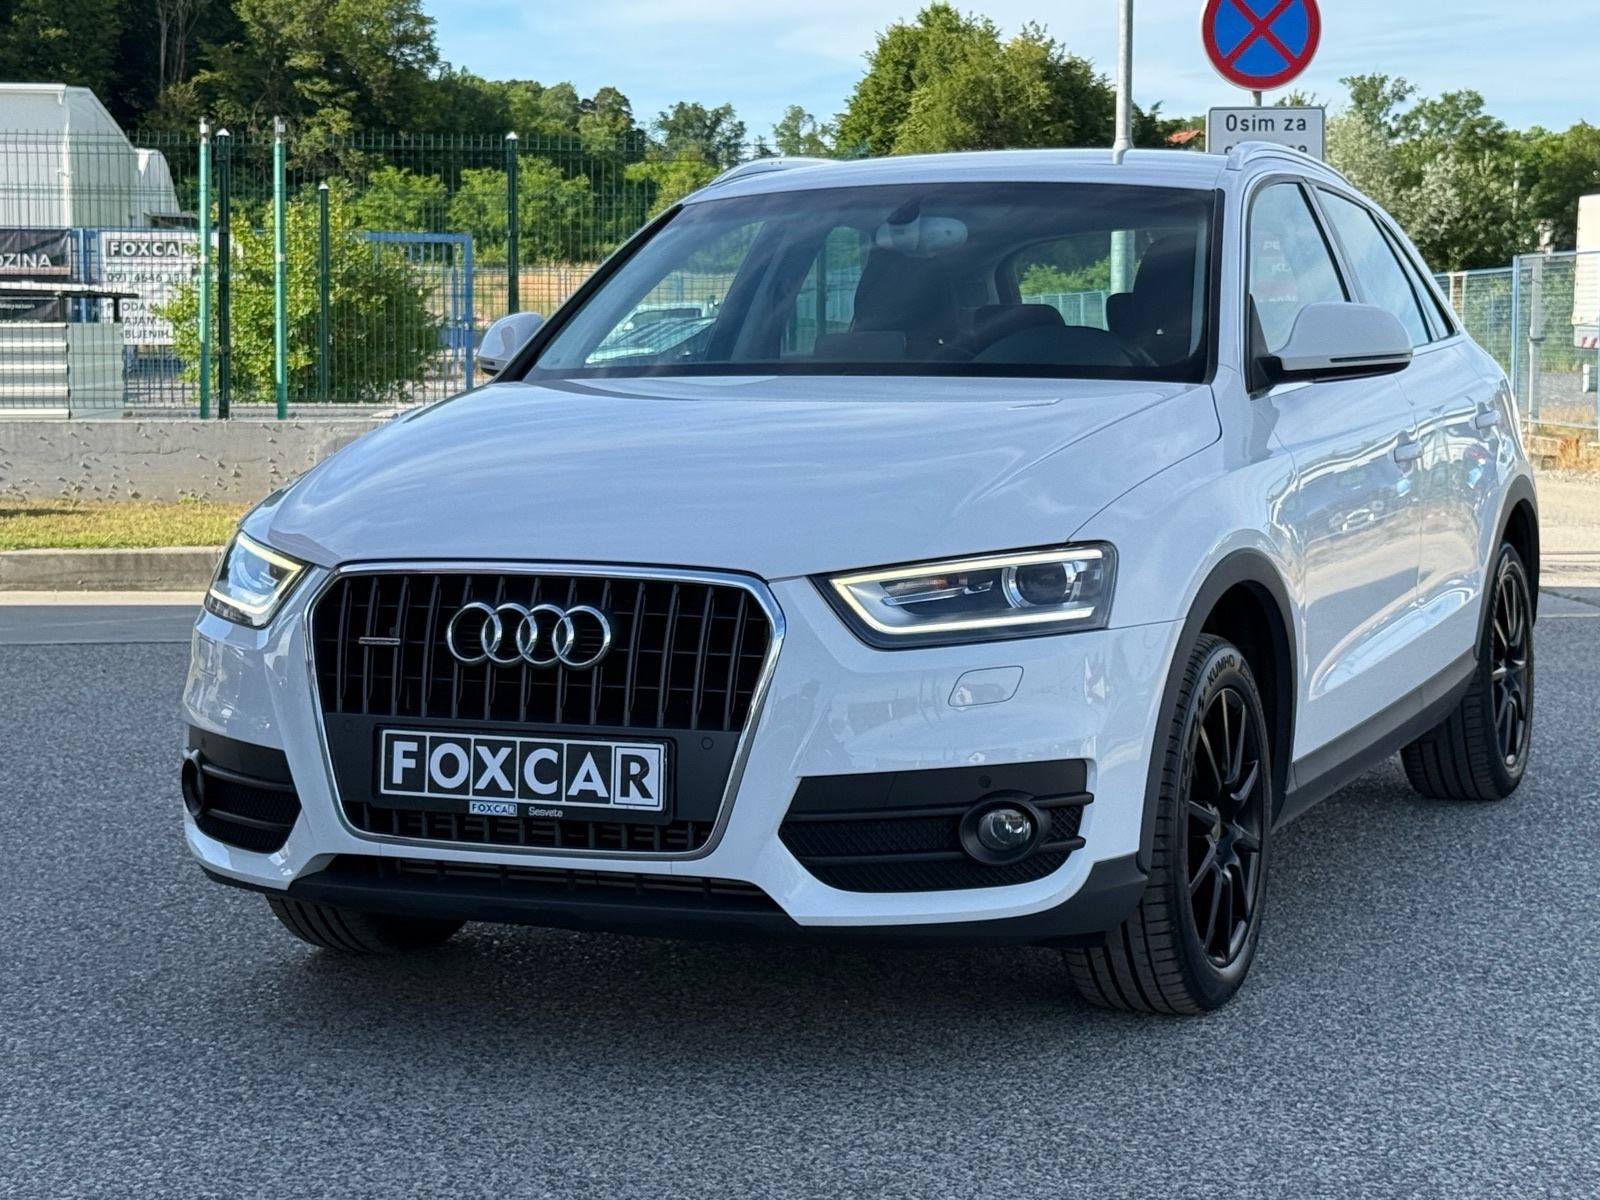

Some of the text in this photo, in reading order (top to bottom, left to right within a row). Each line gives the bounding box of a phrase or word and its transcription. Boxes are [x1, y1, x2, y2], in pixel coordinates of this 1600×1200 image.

[1225, 114, 1307, 132] Osim za
[1207, 654, 1235, 687] KUMHO
[391, 740, 655, 801] FOXCAR
[472, 803, 564, 818] FOXCAR Sesvete
